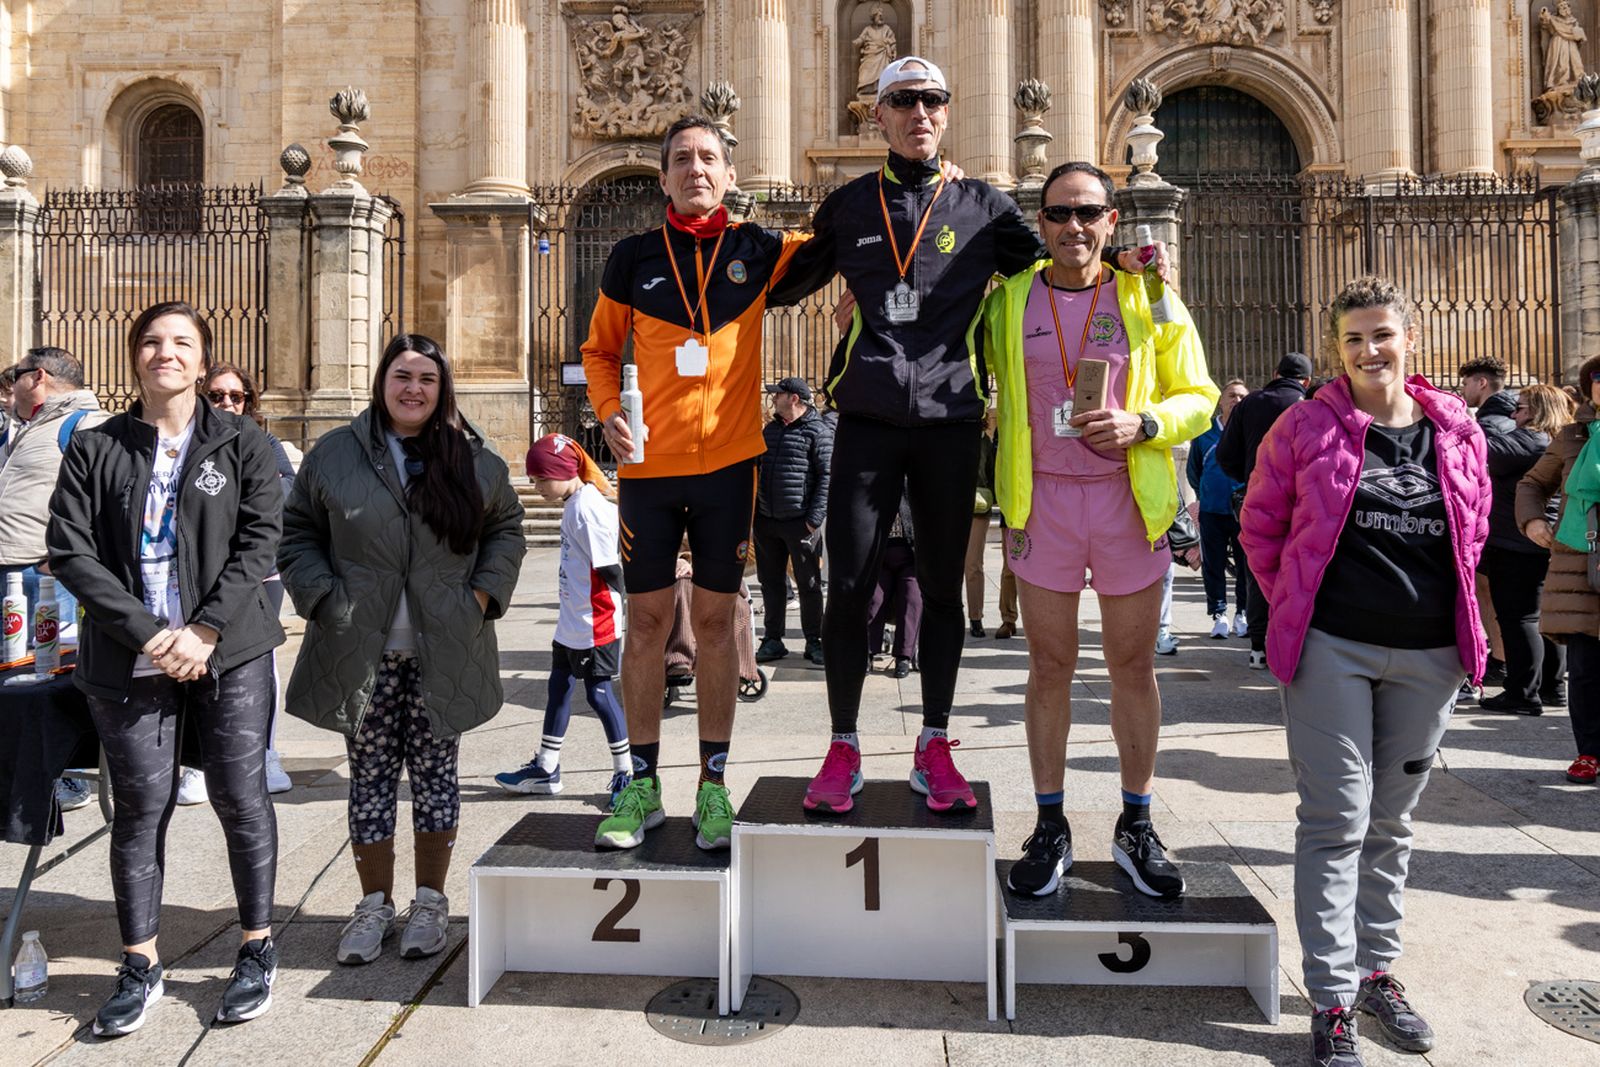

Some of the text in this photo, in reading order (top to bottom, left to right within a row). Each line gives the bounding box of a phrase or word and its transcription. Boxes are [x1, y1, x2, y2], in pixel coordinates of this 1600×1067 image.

[1355, 510, 1445, 536] umbro
[845, 837, 880, 911] 1
[592, 878, 641, 942] 2
[1098, 931, 1151, 973] 3
